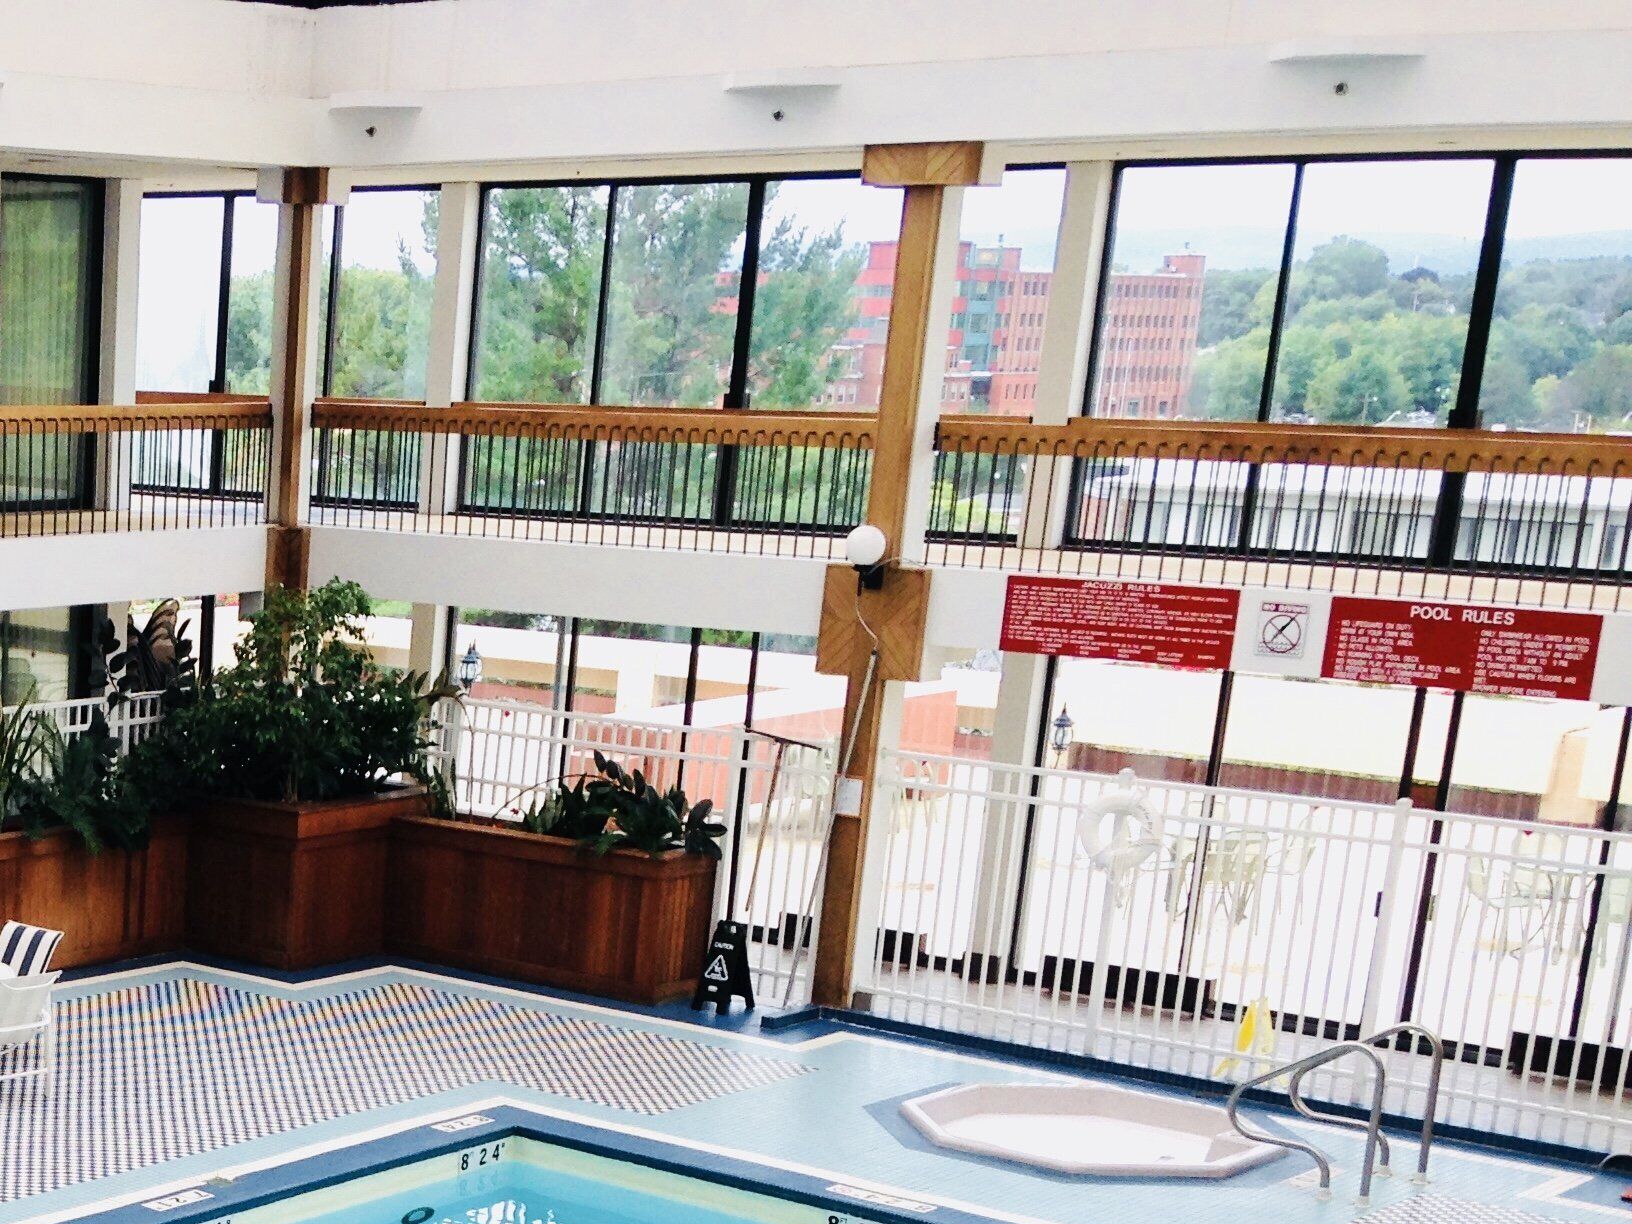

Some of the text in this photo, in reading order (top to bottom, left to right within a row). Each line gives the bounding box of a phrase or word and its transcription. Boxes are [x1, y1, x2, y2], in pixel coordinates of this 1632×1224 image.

[1082, 581, 1161, 592] JACUZZI RULES
[1410, 605, 1515, 625] POOL RULES
